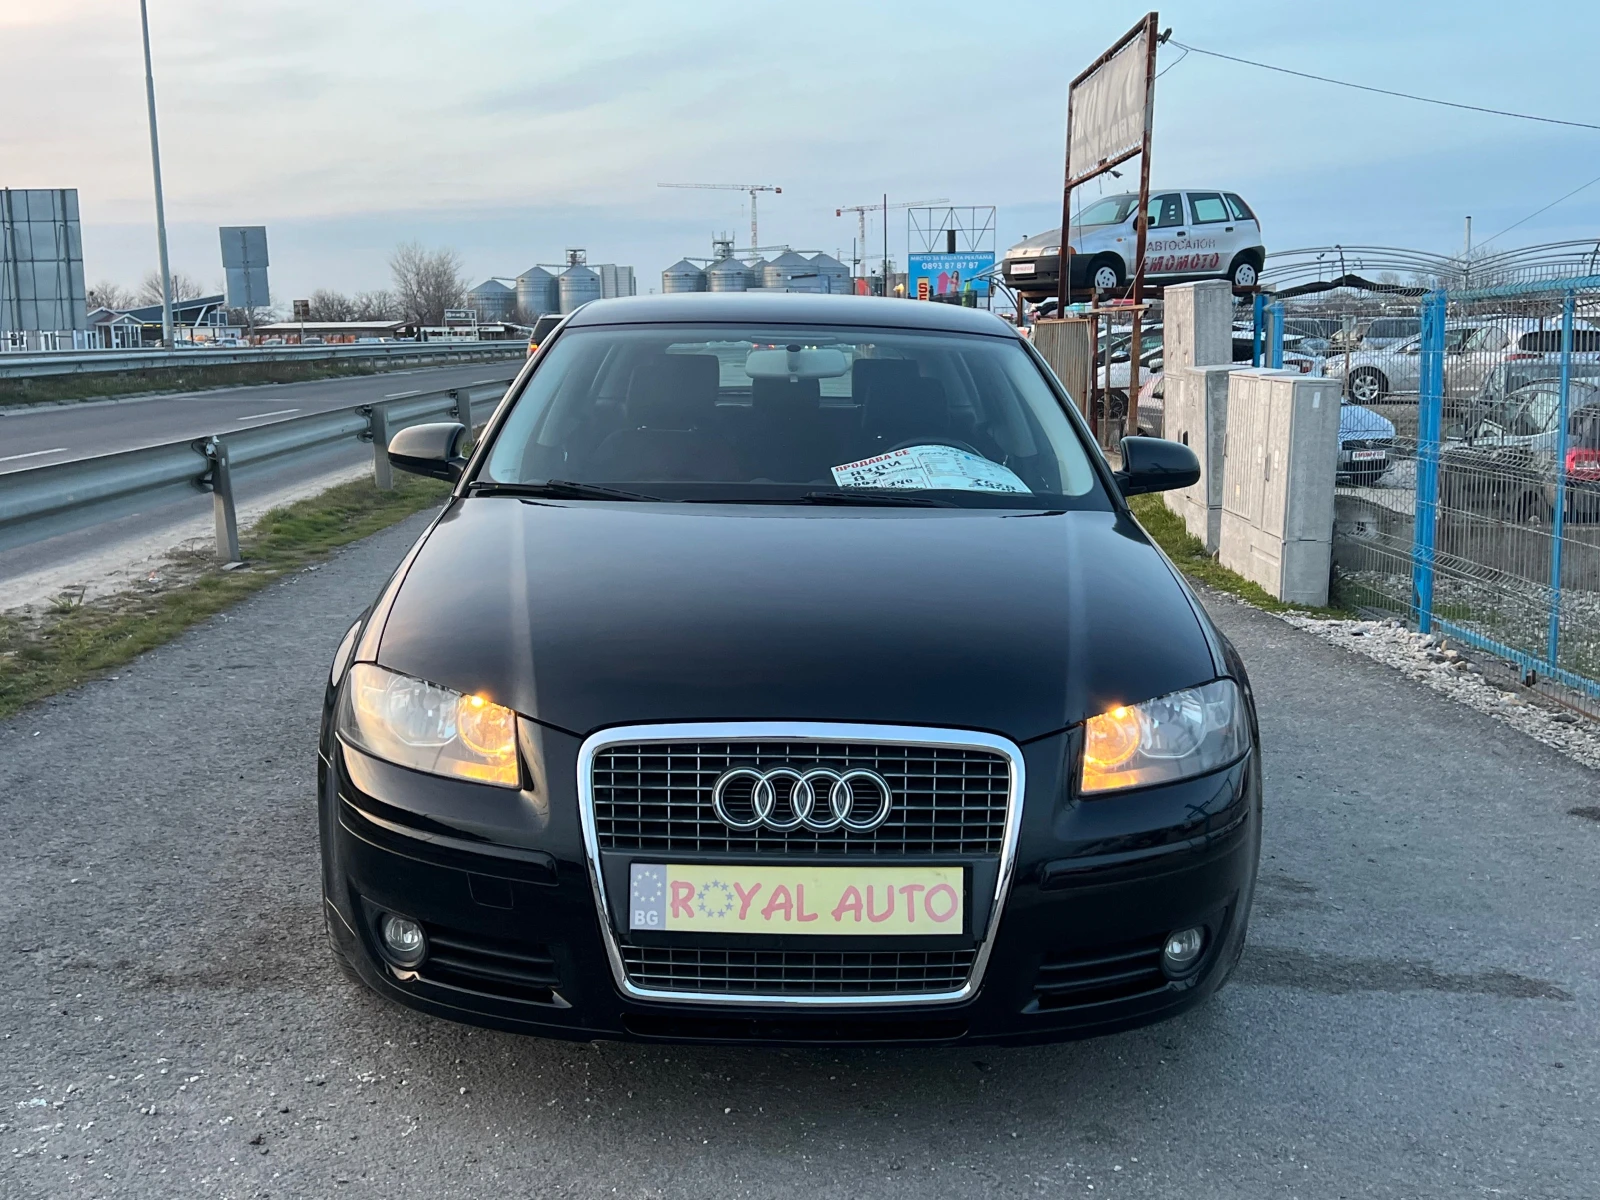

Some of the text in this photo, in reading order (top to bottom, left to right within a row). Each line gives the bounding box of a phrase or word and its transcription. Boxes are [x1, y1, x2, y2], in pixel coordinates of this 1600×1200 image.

[1146, 239, 1216, 252] АВТОСАЛОН
[921, 262, 943, 270] 0893
[944, 262, 955, 270] 87
[968, 261, 979, 269] 87
[835, 454, 892, 472] ПРОДАВА
[894, 449, 910, 457] СЕ
[670, 880, 959, 923] ROYAL AUTO
[634, 910, 659, 926] BG
